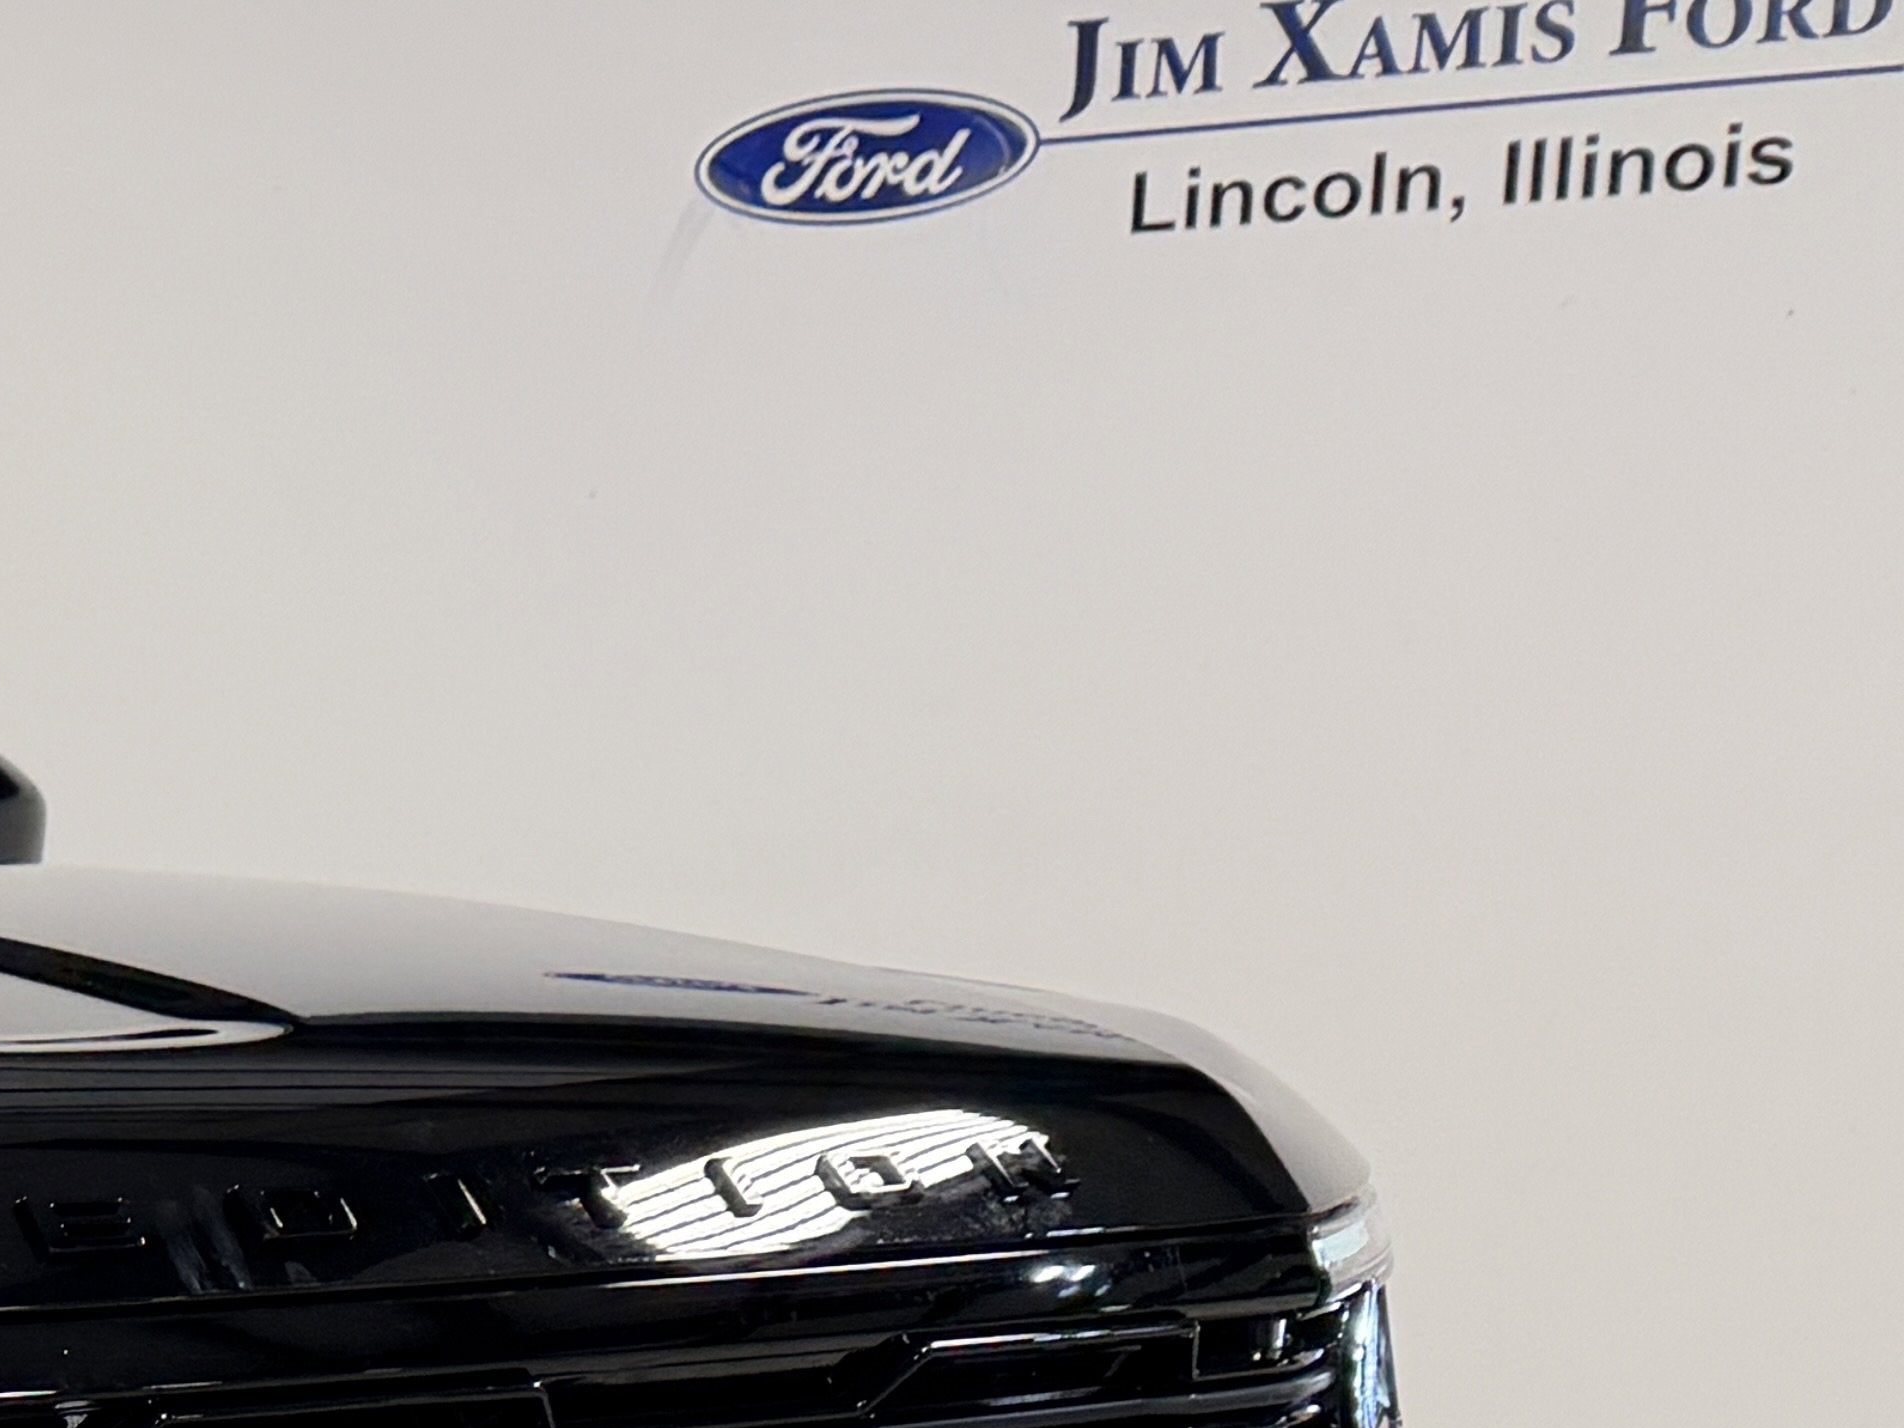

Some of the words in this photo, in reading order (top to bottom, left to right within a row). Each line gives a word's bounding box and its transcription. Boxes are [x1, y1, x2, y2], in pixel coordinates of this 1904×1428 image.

[760, 112, 972, 206] Ford
[1129, 150, 1467, 236] Lincoln,
[1503, 121, 1794, 206] Illinois
